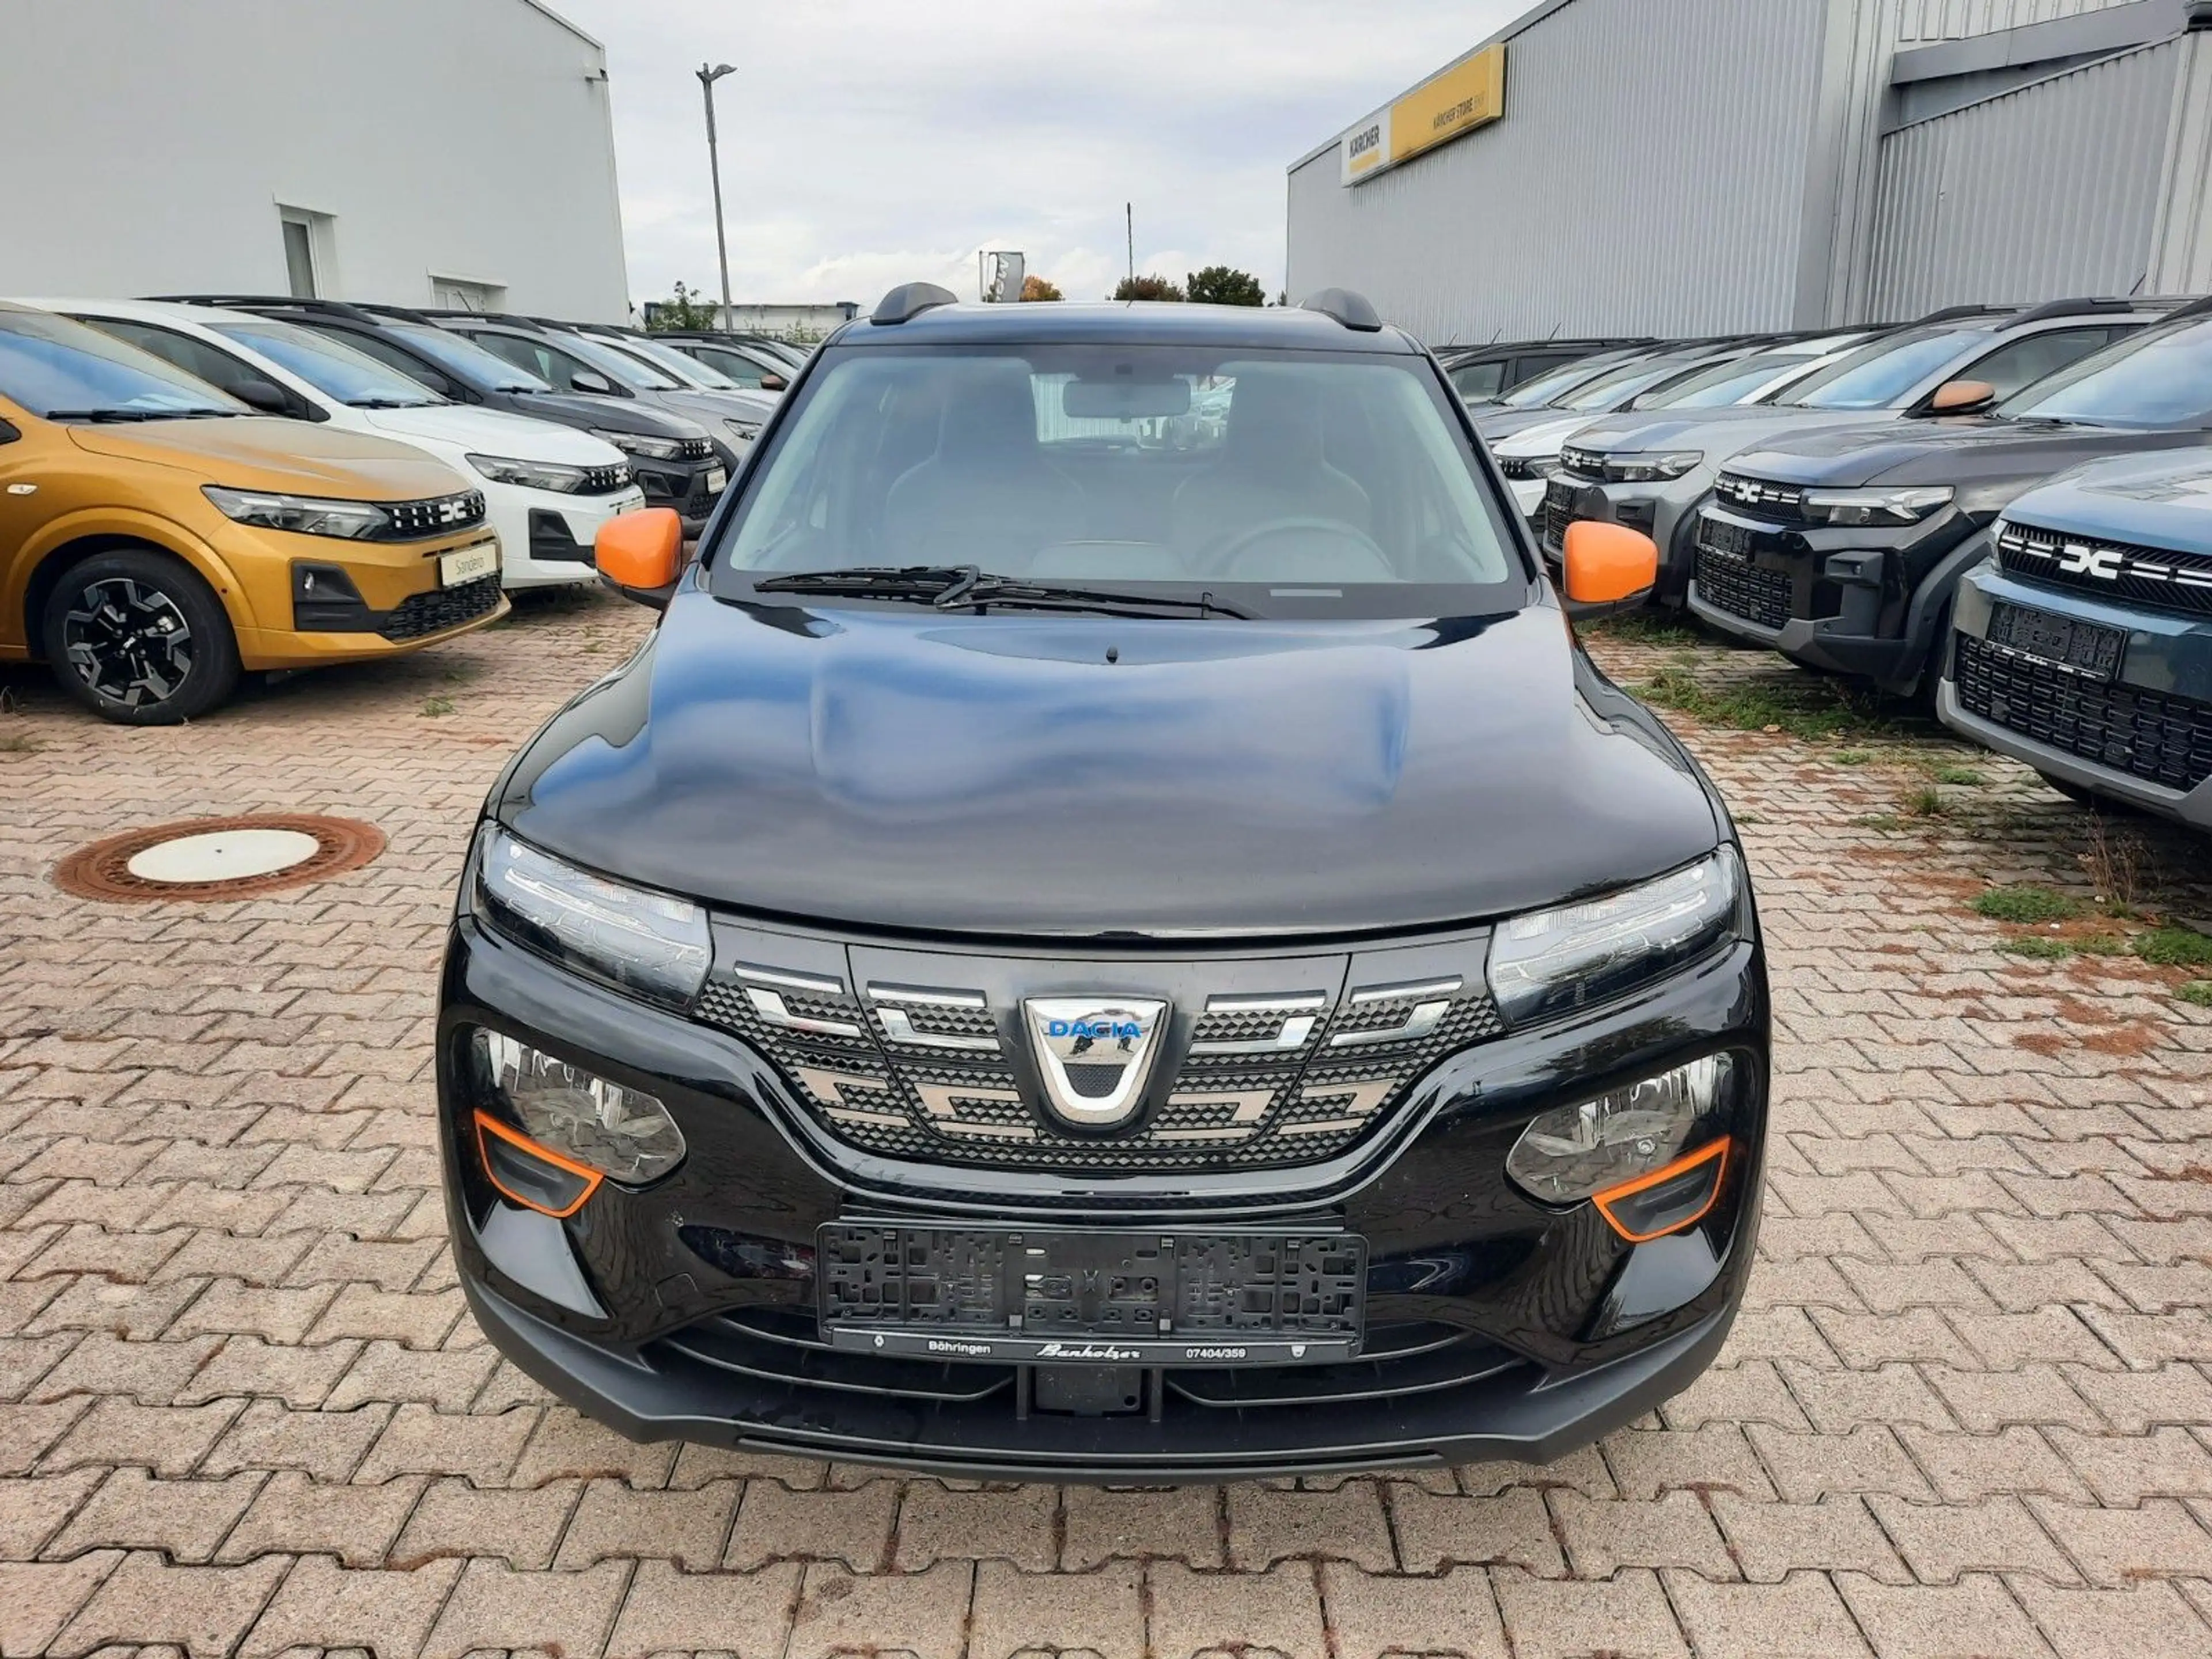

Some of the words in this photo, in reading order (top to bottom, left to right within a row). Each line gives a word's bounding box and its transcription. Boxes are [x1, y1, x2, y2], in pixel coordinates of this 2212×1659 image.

[1048, 1020, 1142, 1039] DACIA
[928, 1340, 991, 1354] Böhringen
[1185, 1348, 1247, 1358] 07404/359
